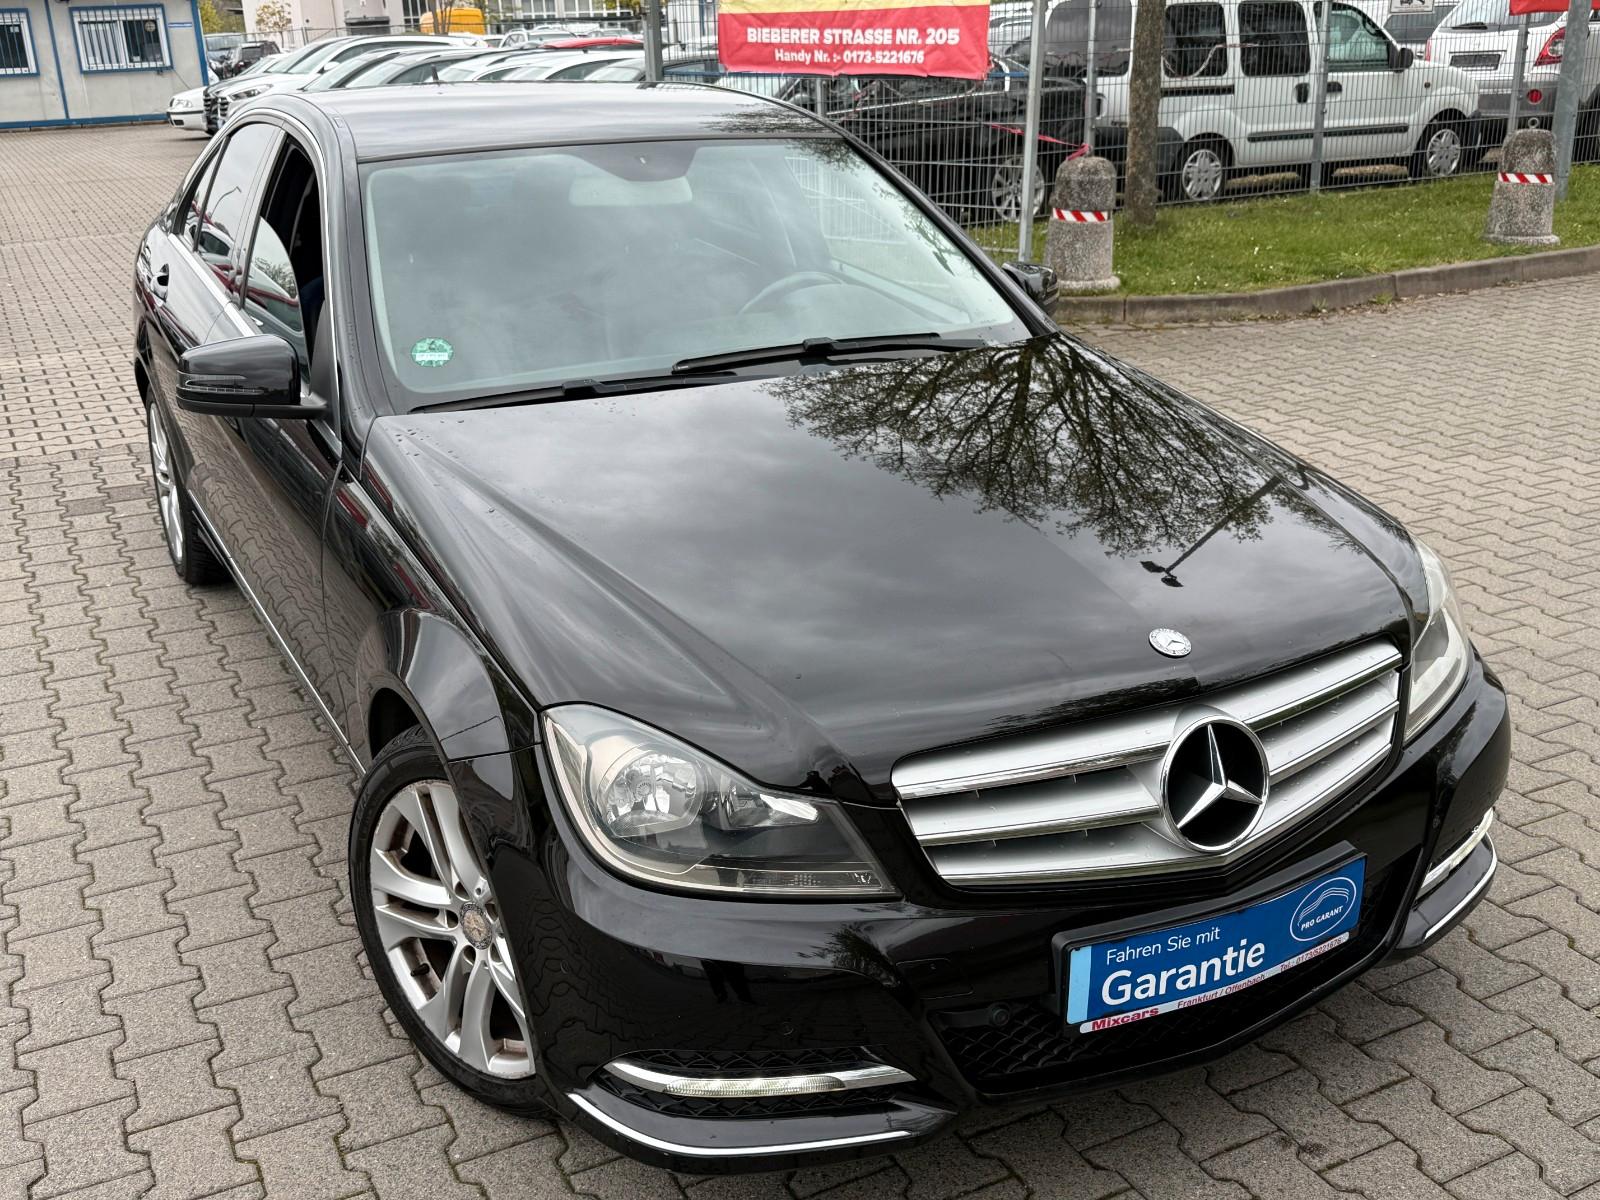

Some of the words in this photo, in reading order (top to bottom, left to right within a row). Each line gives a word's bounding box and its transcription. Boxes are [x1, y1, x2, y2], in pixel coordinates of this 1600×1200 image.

[746, 27, 820, 44] BIEBERER
[823, 28, 893, 45] STRASSE
[895, 28, 922, 45] NR.
[925, 28, 960, 45] 205
[775, 49, 811, 64] Handy
[814, 50, 831, 63] Nr.
[843, 50, 924, 64] 0173-5221676
[1300, 920, 1315, 932] PRO
[1316, 905, 1344, 923] GARANT
[1106, 943, 1162, 965] Fahren
[1167, 935, 1192, 952] Sie
[1196, 927, 1221, 945] mit
[1101, 938, 1265, 1006] Garantie
[1091, 1007, 1160, 1031] Mixcars
[1177, 989, 1219, 1008] Frankfurt
[1224, 974, 1266, 995] Offenbach
